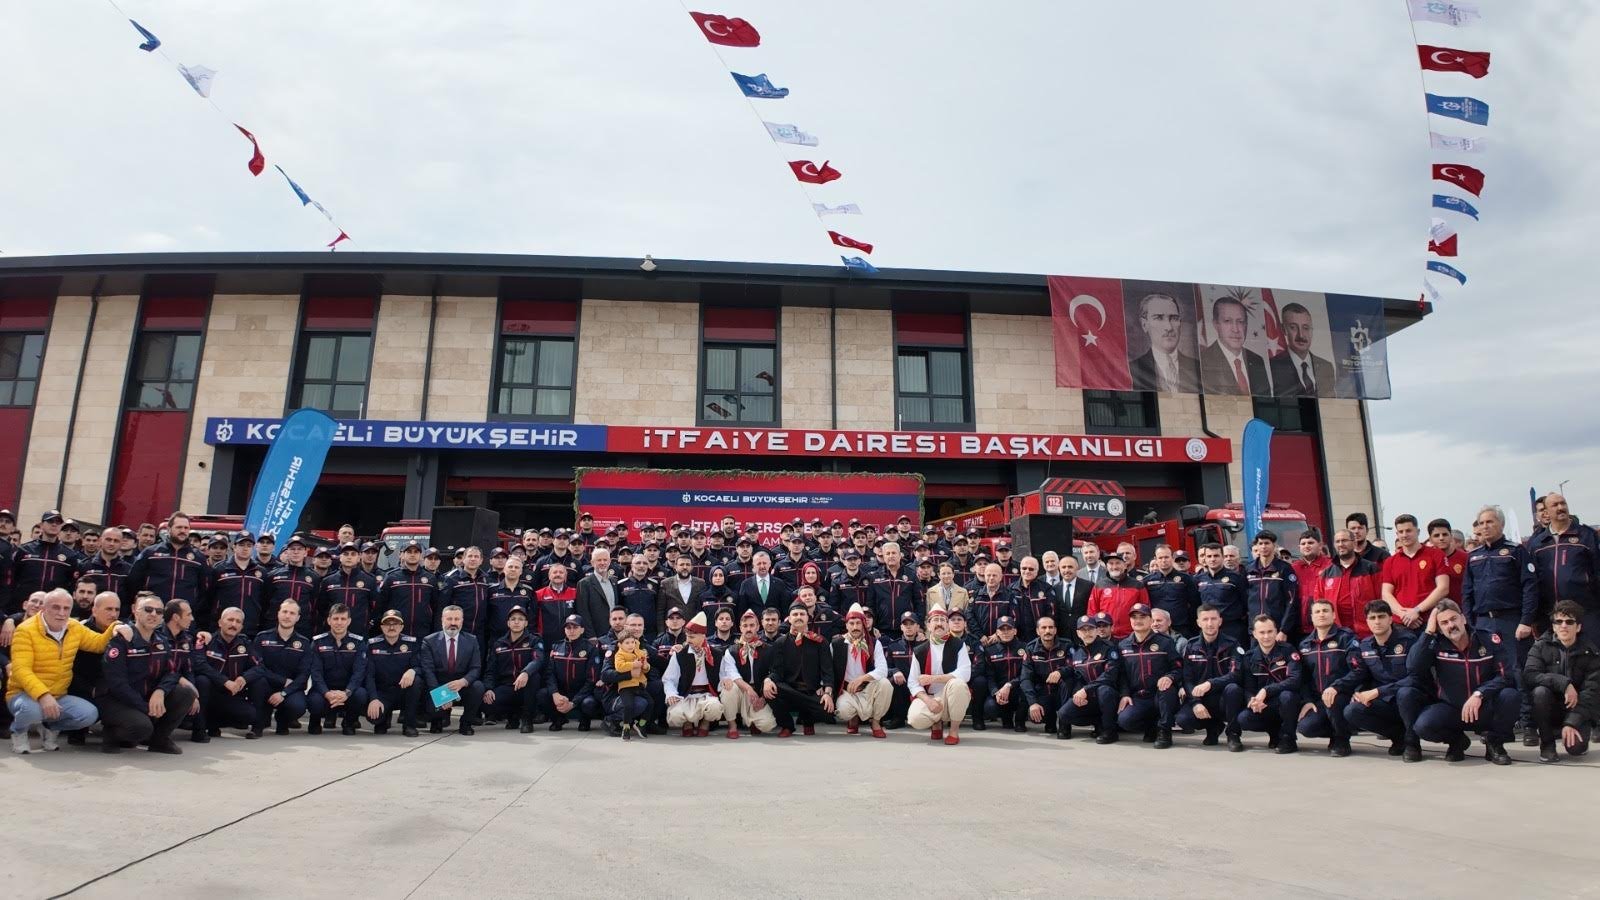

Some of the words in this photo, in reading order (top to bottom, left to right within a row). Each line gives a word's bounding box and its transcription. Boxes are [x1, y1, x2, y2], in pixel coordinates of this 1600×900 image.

[383, 426, 578, 448] BÜYÜKŞEHİR
[643, 429, 789, 450] İTFAİYE
[804, 432, 946, 454] DAİRESİ
[1048, 497, 1061, 506] 112
